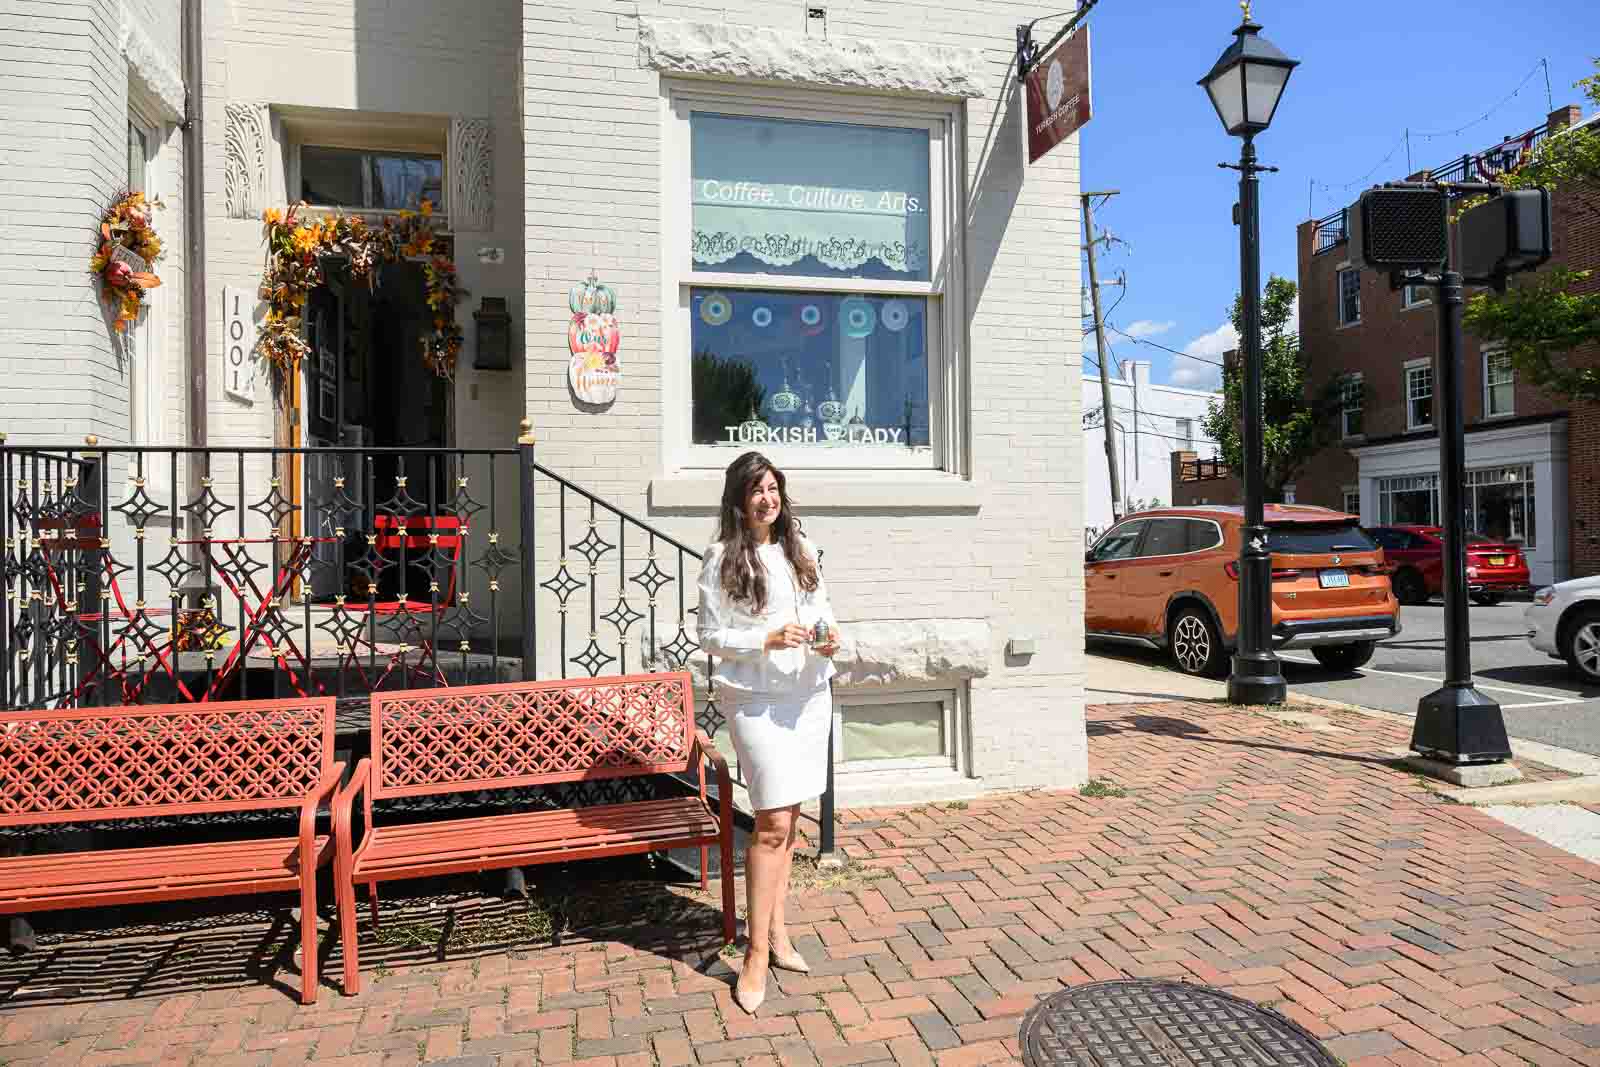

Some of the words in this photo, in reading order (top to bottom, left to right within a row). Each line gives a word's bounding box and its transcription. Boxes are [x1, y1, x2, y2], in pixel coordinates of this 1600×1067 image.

[1035, 111, 1058, 135] TURKISH
[1058, 95, 1080, 117] COFFEE
[877, 191, 923, 213] Arts.
[229, 295, 244, 391] 1001
[725, 426, 817, 443] TURKISH
[849, 428, 902, 443] LADY
